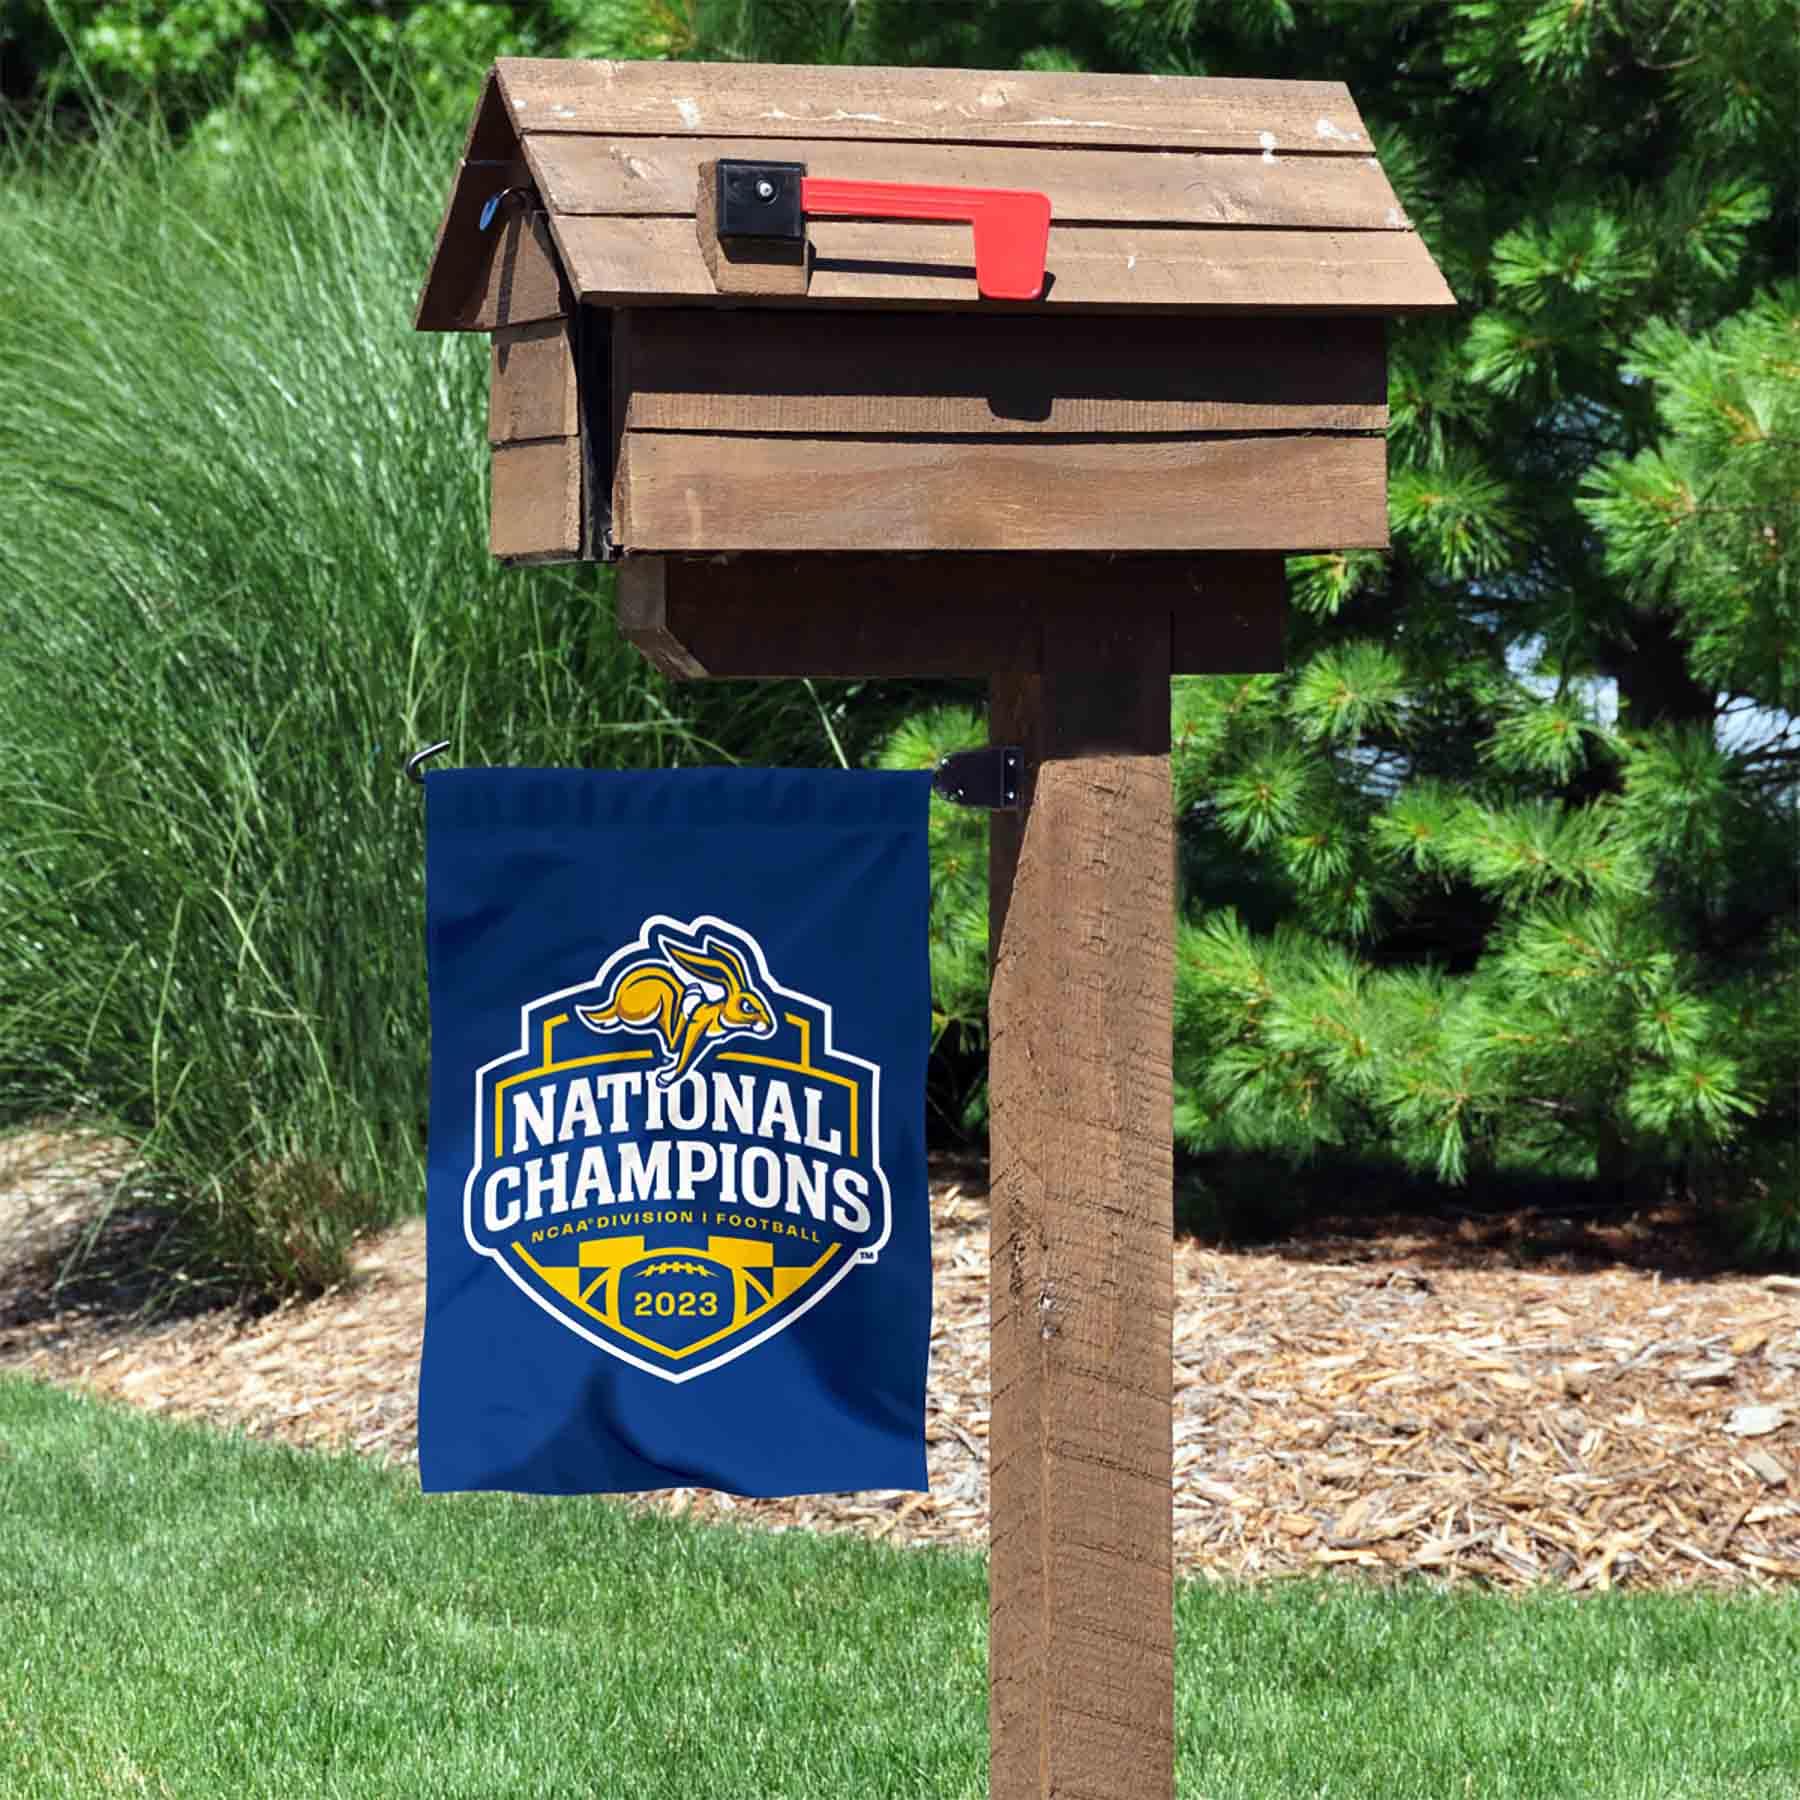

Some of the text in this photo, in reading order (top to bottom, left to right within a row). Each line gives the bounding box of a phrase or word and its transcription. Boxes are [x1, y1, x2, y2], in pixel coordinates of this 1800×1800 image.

[512, 1071, 842, 1156] NATIONAL
[483, 1139, 872, 1233] CHAMPIONS
[597, 1211, 694, 1229] DIVISION
[716, 1213, 821, 1243] FOOTBALL
[633, 1291, 719, 1317] 2023
